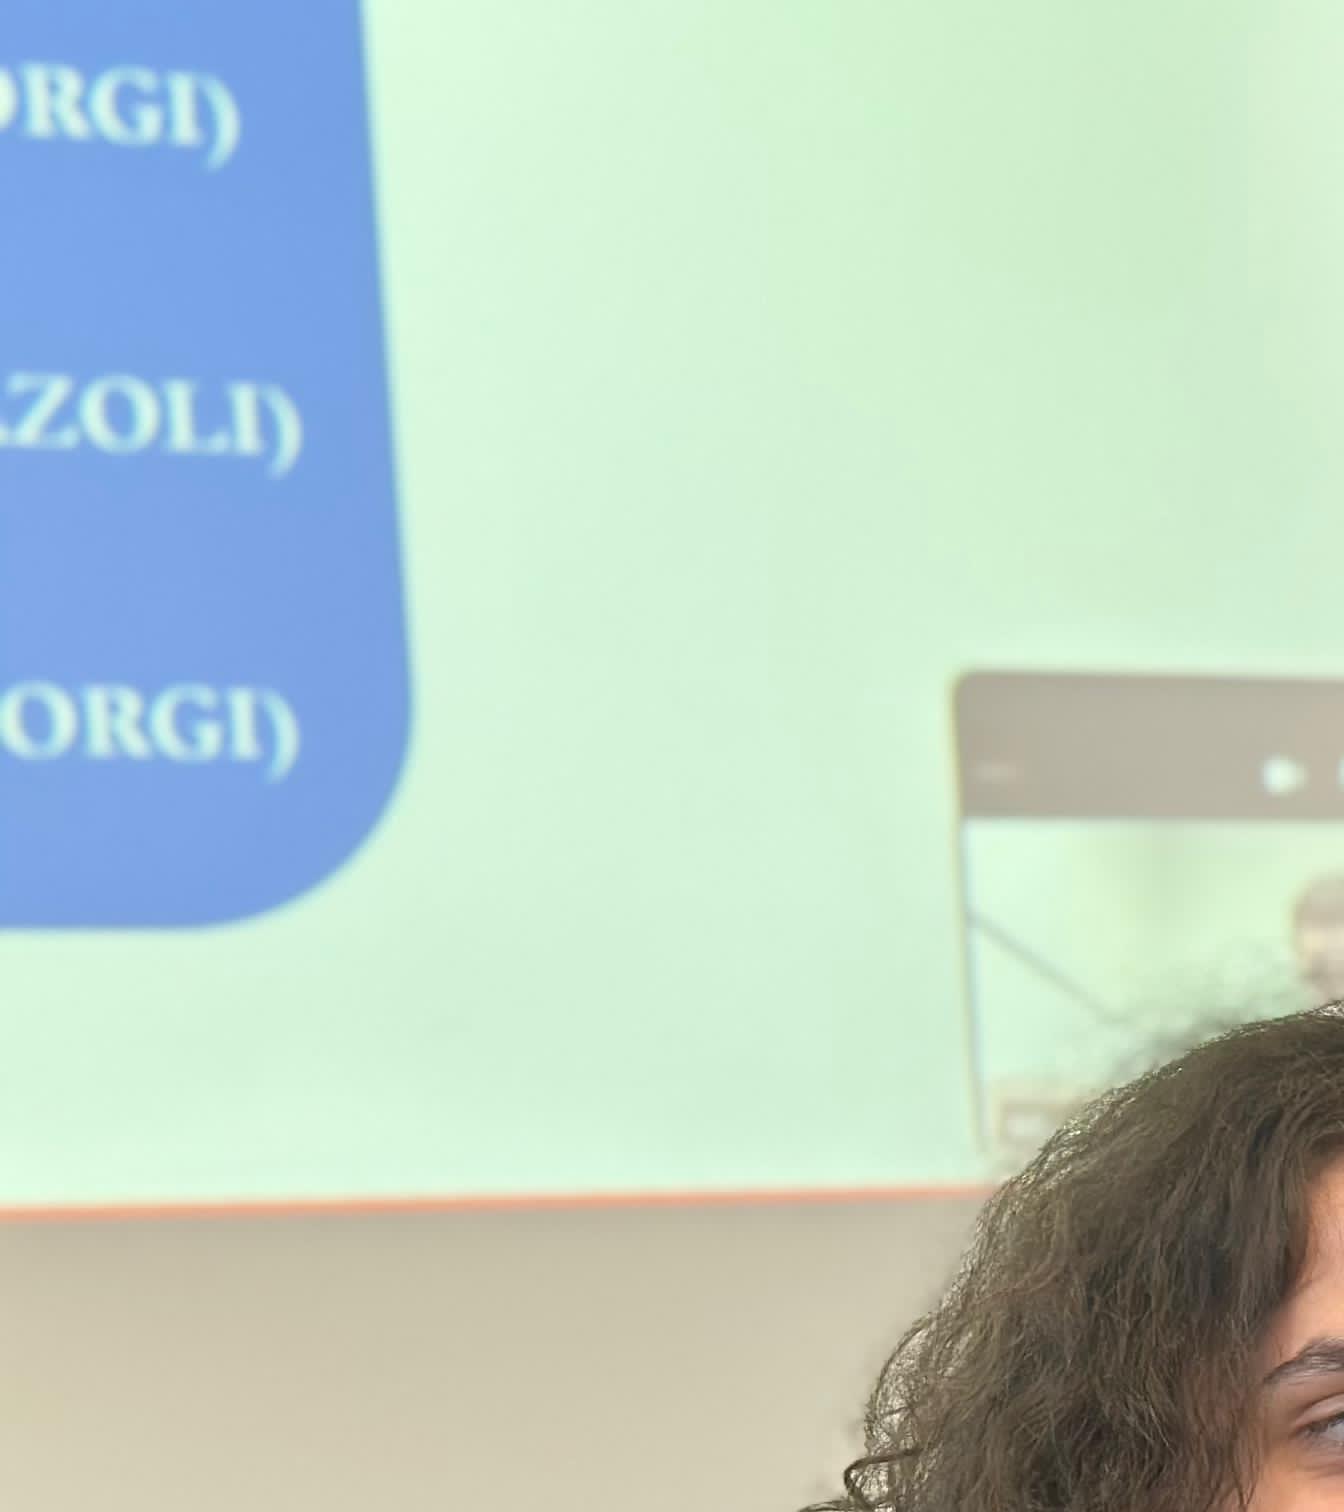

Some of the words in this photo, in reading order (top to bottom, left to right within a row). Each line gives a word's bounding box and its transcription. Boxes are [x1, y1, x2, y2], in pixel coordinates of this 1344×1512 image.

[0, 63, 240, 173] RGI)
[0, 371, 302, 480] ZOLI)
[0, 679, 299, 784] ORGI)
